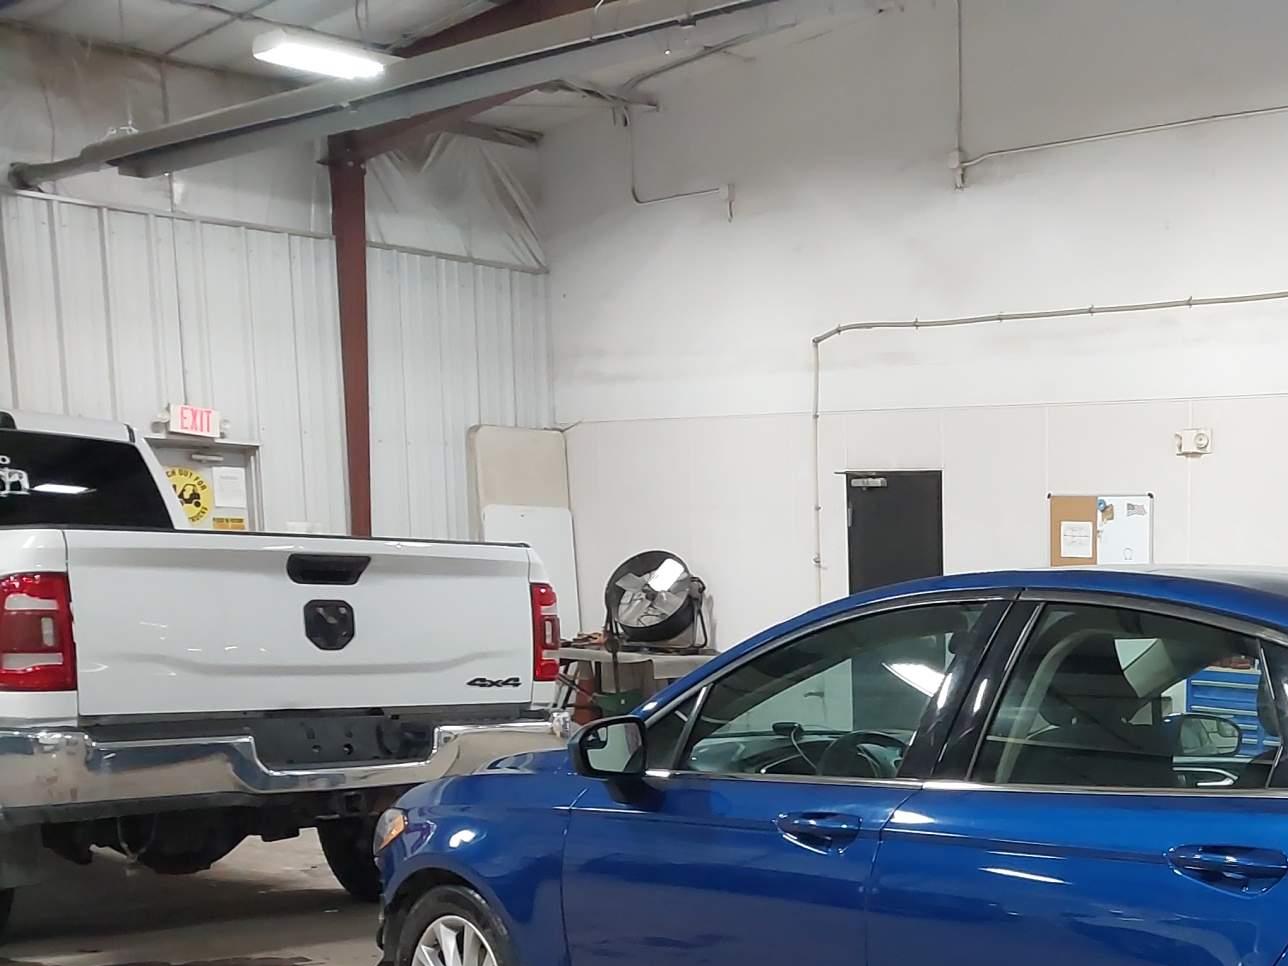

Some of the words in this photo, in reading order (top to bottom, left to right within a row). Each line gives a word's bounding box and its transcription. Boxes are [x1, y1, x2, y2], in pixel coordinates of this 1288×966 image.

[180, 406, 212, 433] EXIT
[178, 468, 193, 479] OUT
[193, 477, 207, 490] FOR
[467, 678, 522, 688] 4x4
